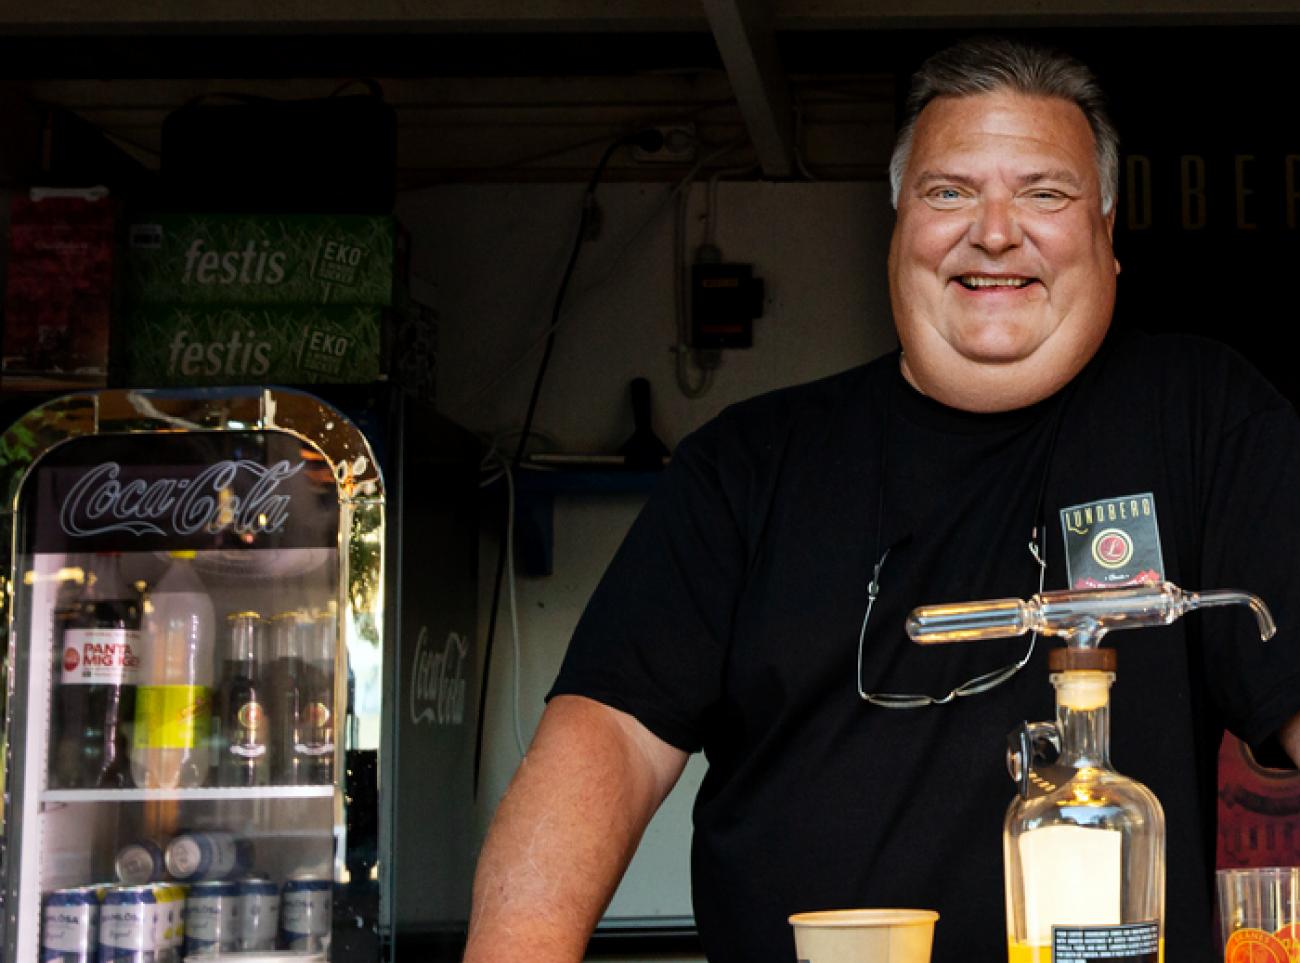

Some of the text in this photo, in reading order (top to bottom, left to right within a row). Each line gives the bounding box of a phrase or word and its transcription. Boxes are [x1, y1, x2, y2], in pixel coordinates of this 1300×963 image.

[182, 239, 287, 286] festis
[324, 240, 361, 266] EKO
[167, 330, 273, 377] festis
[311, 331, 348, 357] EKO
[83, 643, 132, 654] PANTA
